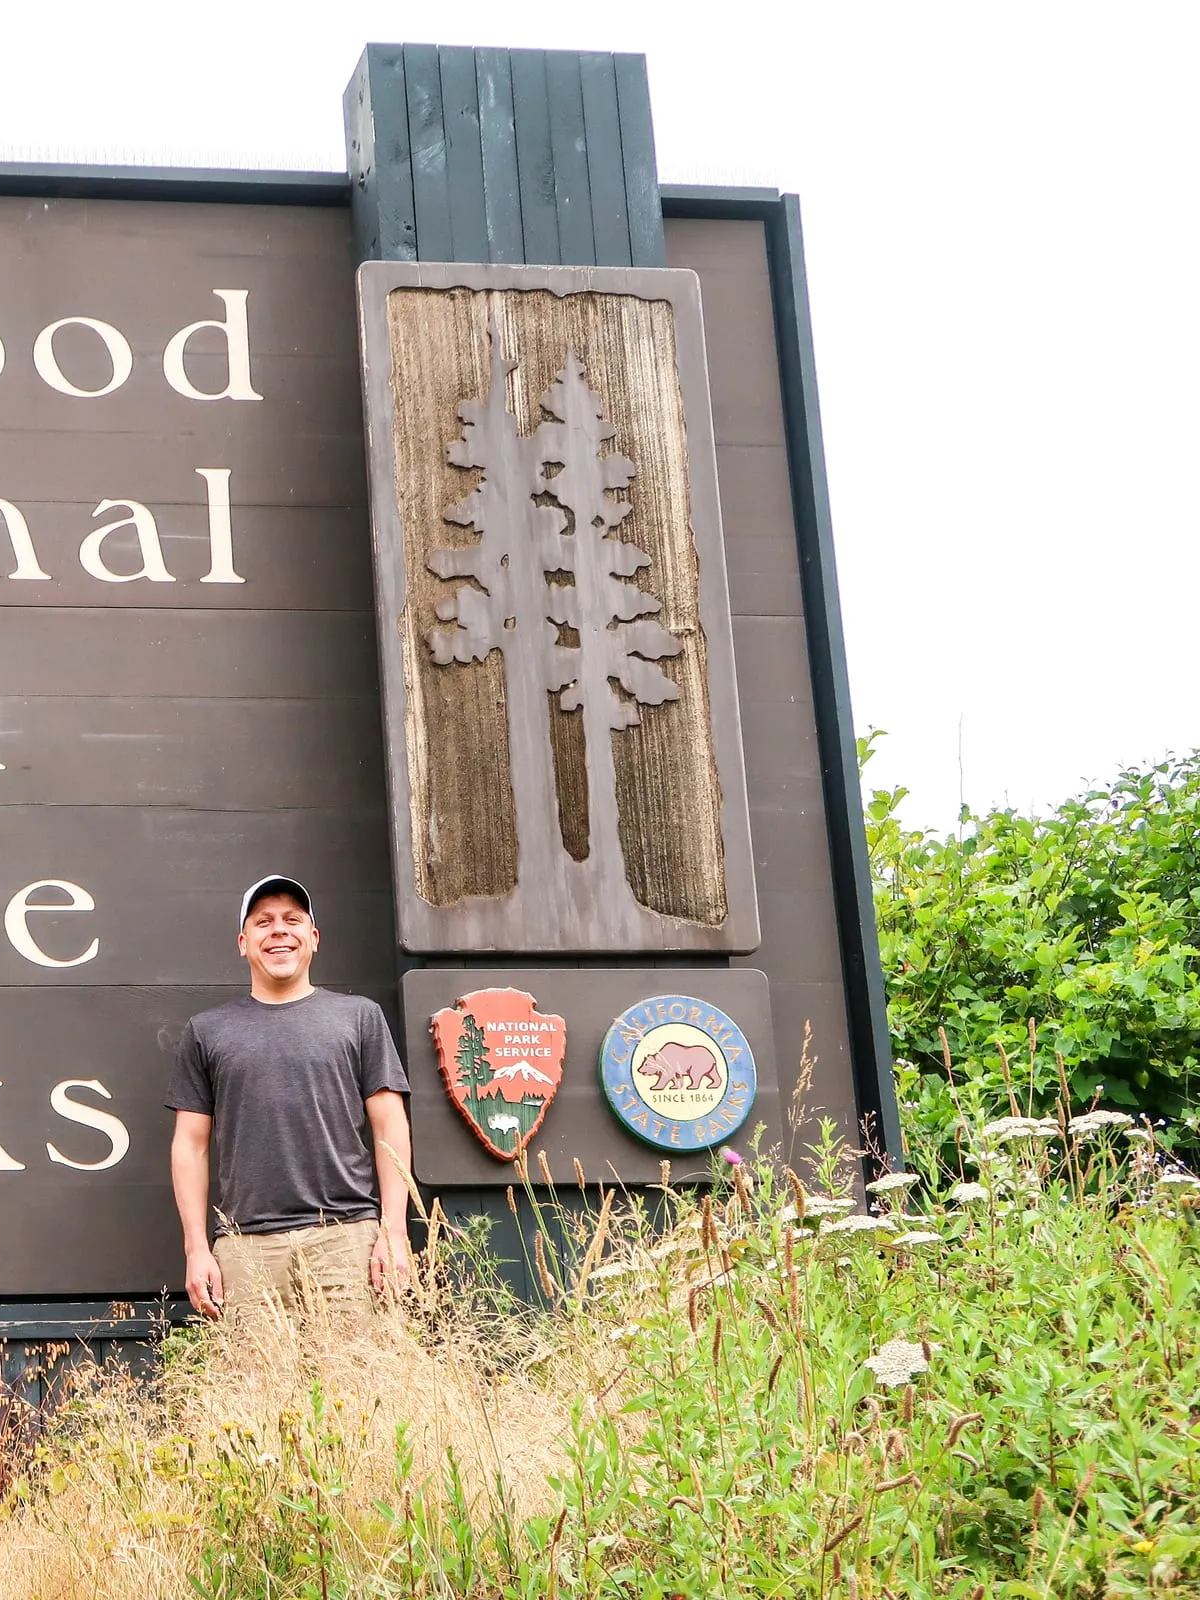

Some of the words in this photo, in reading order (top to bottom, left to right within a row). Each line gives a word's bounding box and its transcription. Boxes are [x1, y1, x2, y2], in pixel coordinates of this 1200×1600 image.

[486, 1021, 557, 1033] NATIONAL
[611, 1003, 741, 1064] CALIFORNIA
[504, 1034, 541, 1045] PARK
[495, 1047, 552, 1058] SERVICE
[652, 1094, 685, 1104] SINCE
[689, 1094, 714, 1104] 1864
[613, 1082, 681, 1145] STATE
[694, 1080, 749, 1144] PARKS
